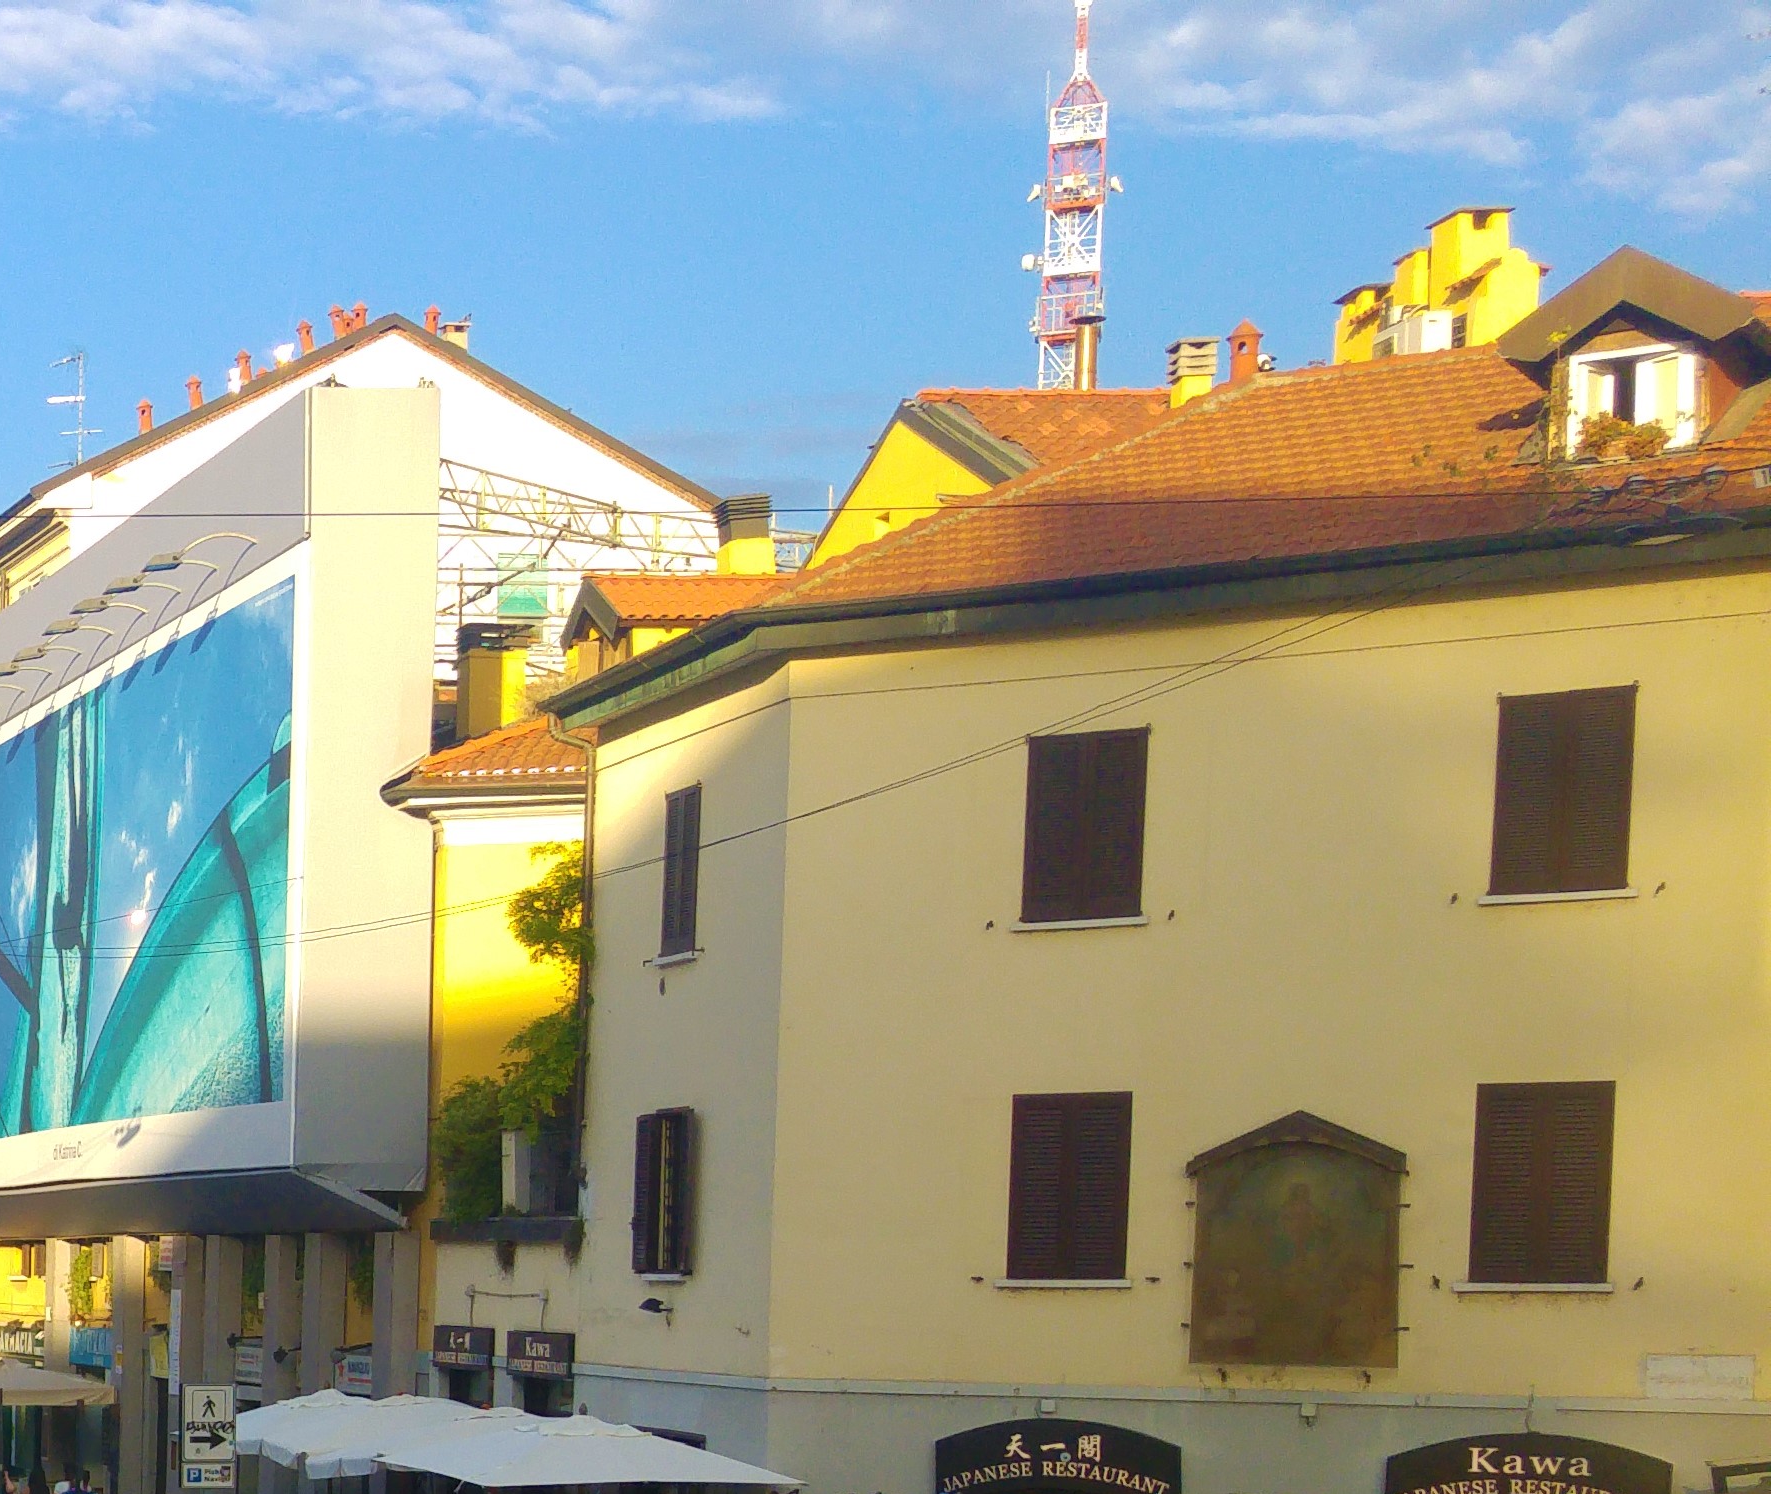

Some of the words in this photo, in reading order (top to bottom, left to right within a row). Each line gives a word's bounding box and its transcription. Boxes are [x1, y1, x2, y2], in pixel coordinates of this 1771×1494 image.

[525, 1337, 550, 1357] Kawa
[943, 1461, 1033, 1493] JAPANESE
[1467, 1447, 1592, 1477] Kawa
